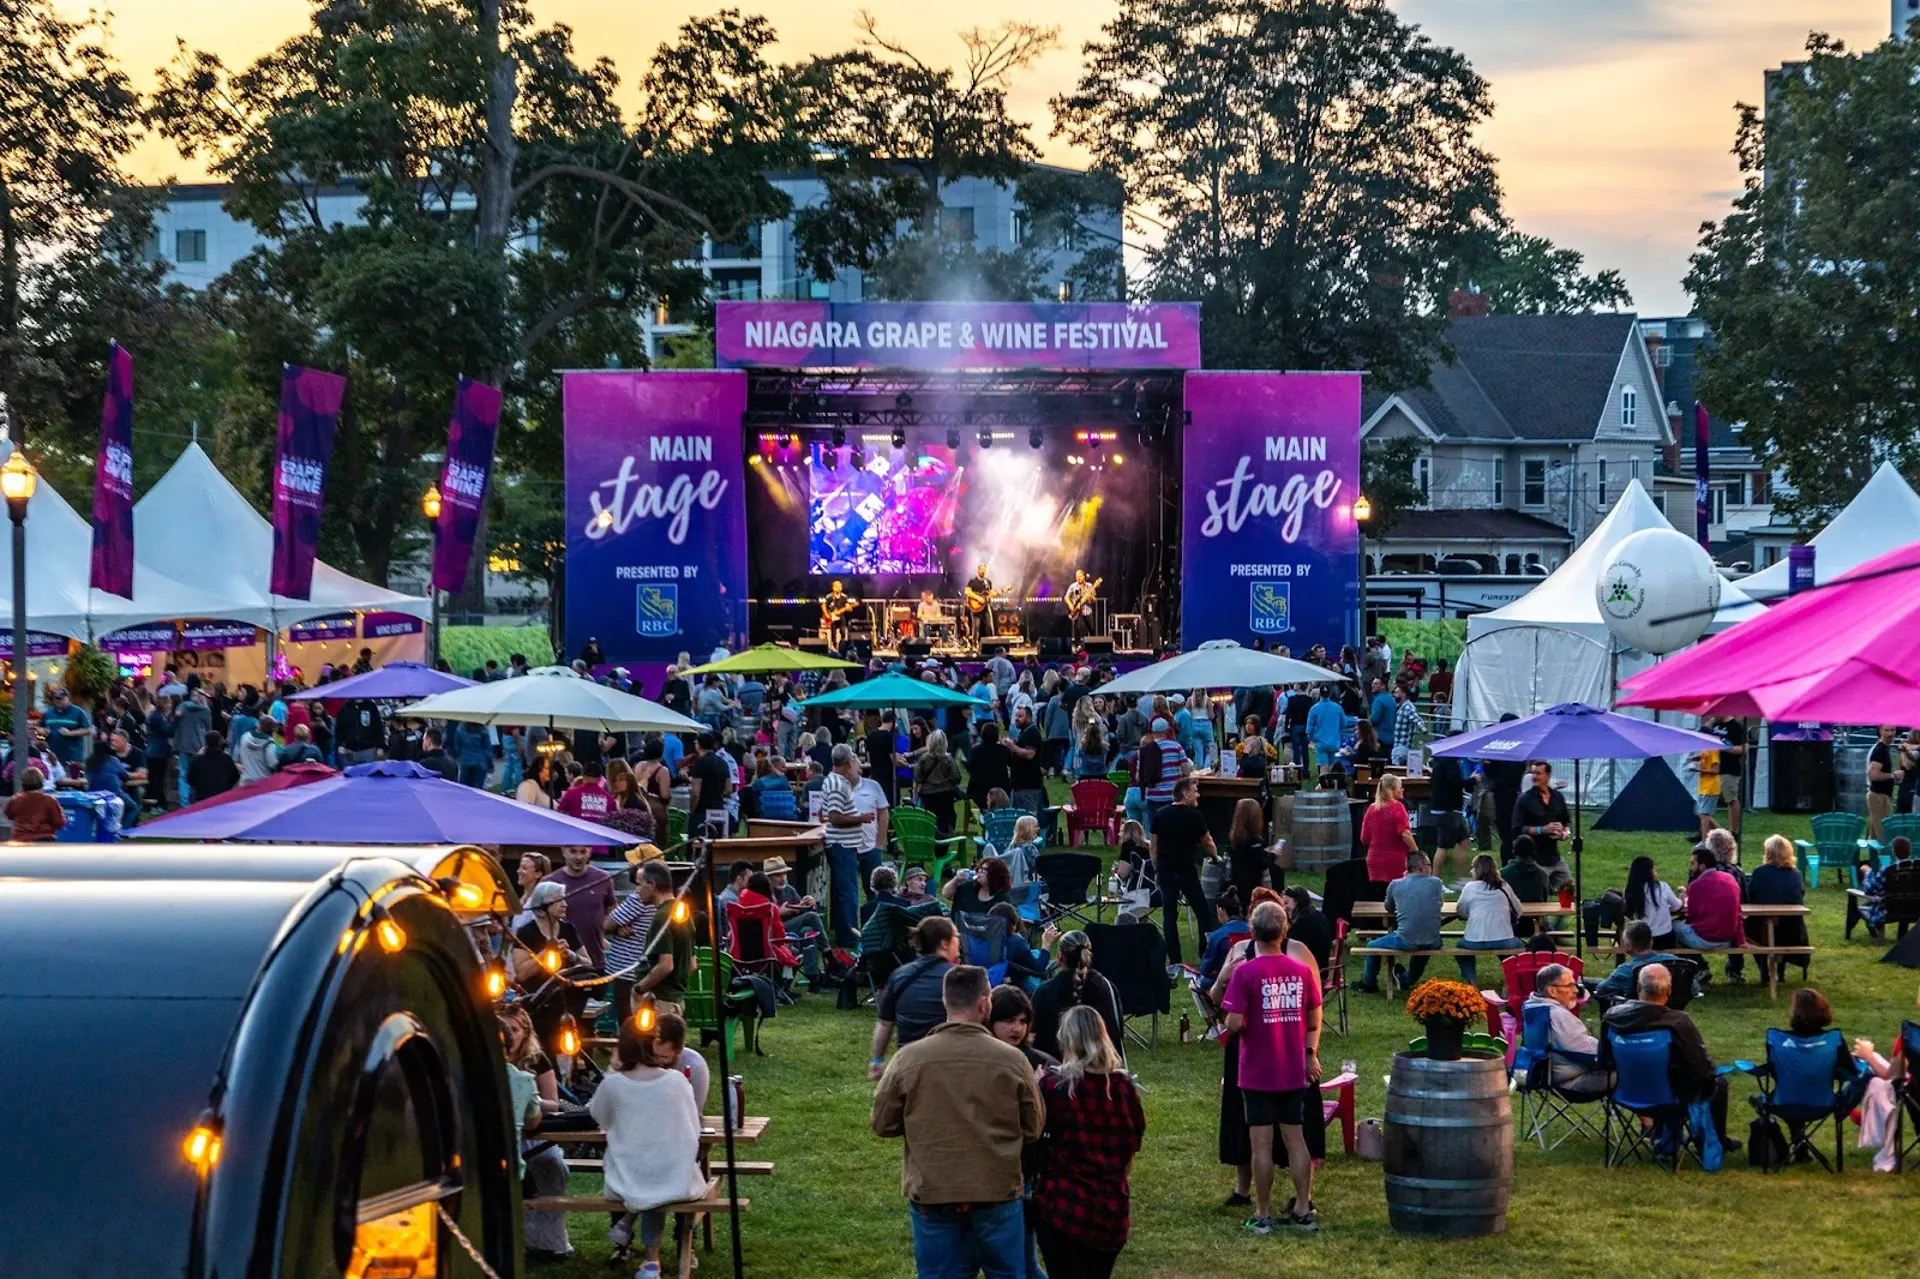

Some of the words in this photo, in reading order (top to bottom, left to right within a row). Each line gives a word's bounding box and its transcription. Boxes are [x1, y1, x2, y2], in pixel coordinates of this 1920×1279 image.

[745, 321, 861, 348] NIAGARA
[867, 321, 952, 348] GRAPE
[958, 321, 976, 349] &
[981, 322, 1047, 349] WINE
[1054, 322, 1168, 349] FESTIVAL
[650, 436, 712, 461] MAIN
[1265, 437, 1326, 461] MAIN
[585, 456, 729, 545] stage
[1201, 455, 1342, 543] stage
[616, 566, 679, 579] PRESENTED
[684, 566, 699, 578] BY
[1230, 564, 1291, 576] PRESENTED
[1297, 564, 1312, 576] BY
[641, 620, 673, 632] RBC
[1255, 617, 1286, 629] RBC
[1261, 976, 1303, 984] NIAGARA
[1261, 982, 1304, 996] GRAPE
